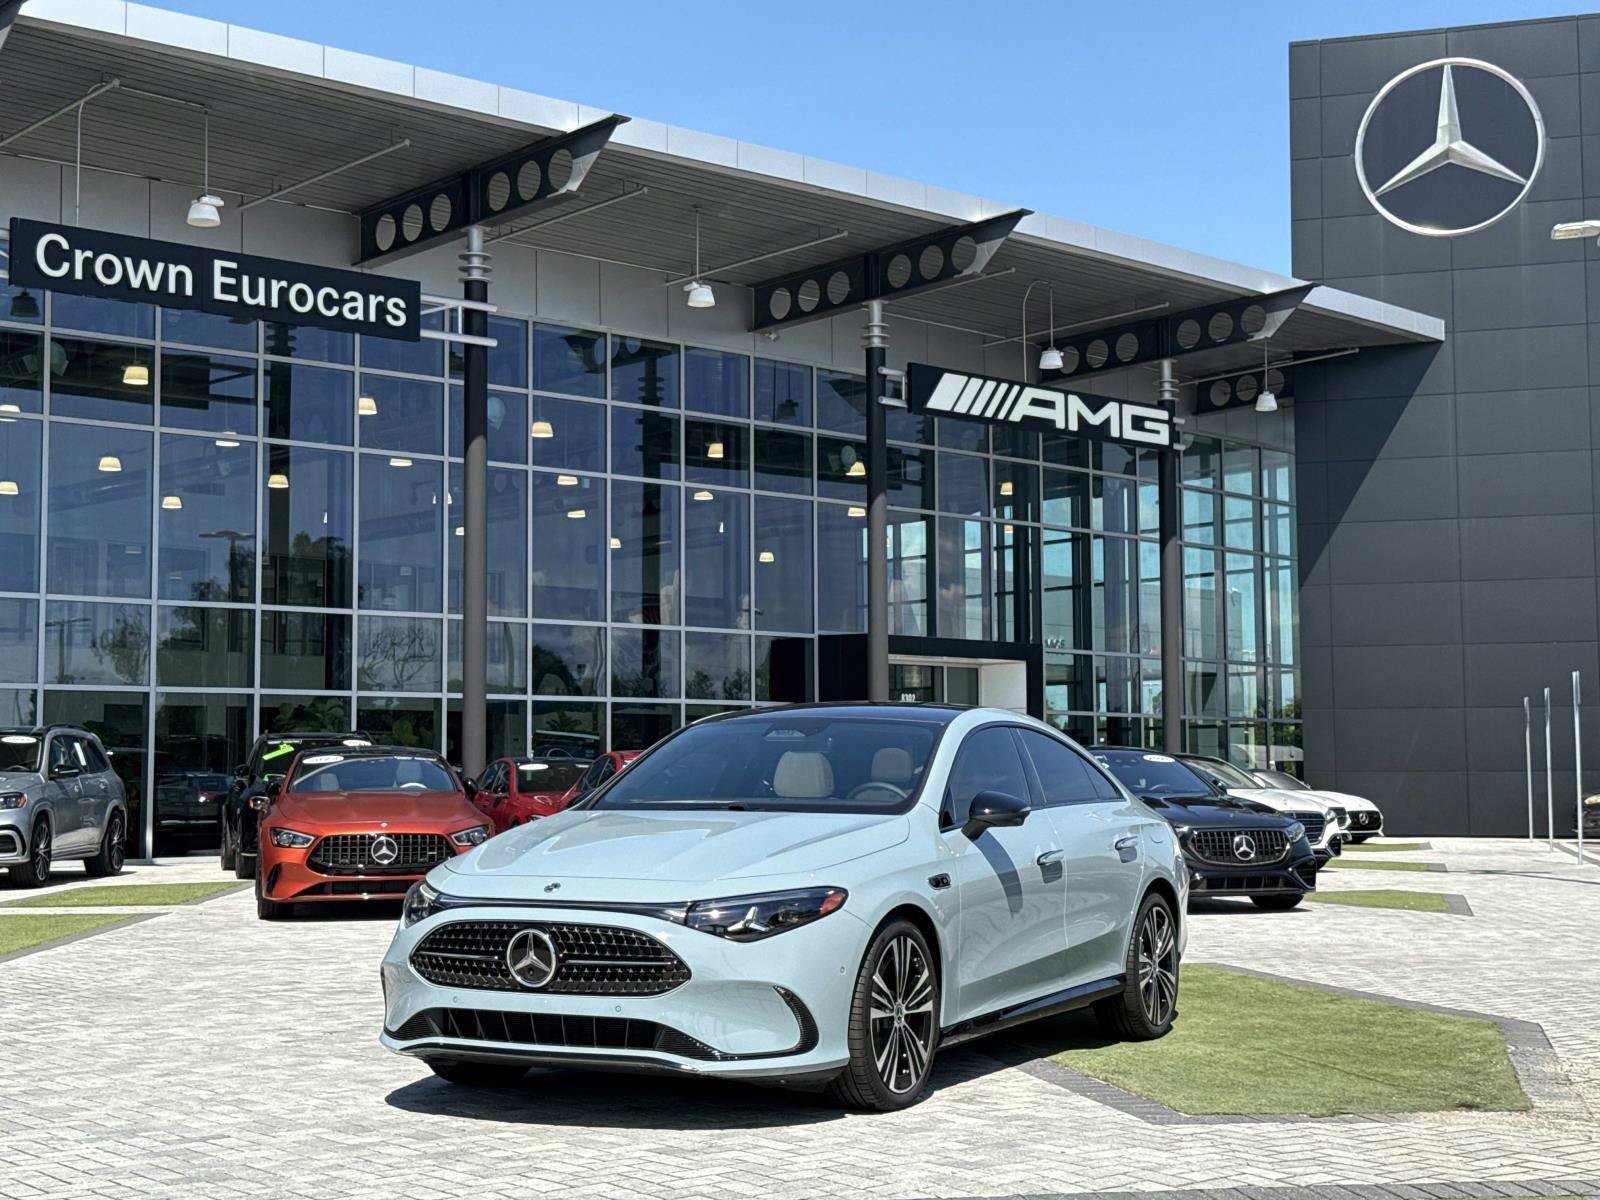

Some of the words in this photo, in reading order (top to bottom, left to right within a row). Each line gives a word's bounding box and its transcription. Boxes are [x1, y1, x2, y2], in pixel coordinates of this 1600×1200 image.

[35, 233, 194, 297] Crown
[213, 259, 408, 328] Eurocars
[1008, 387, 1170, 446] AMG
